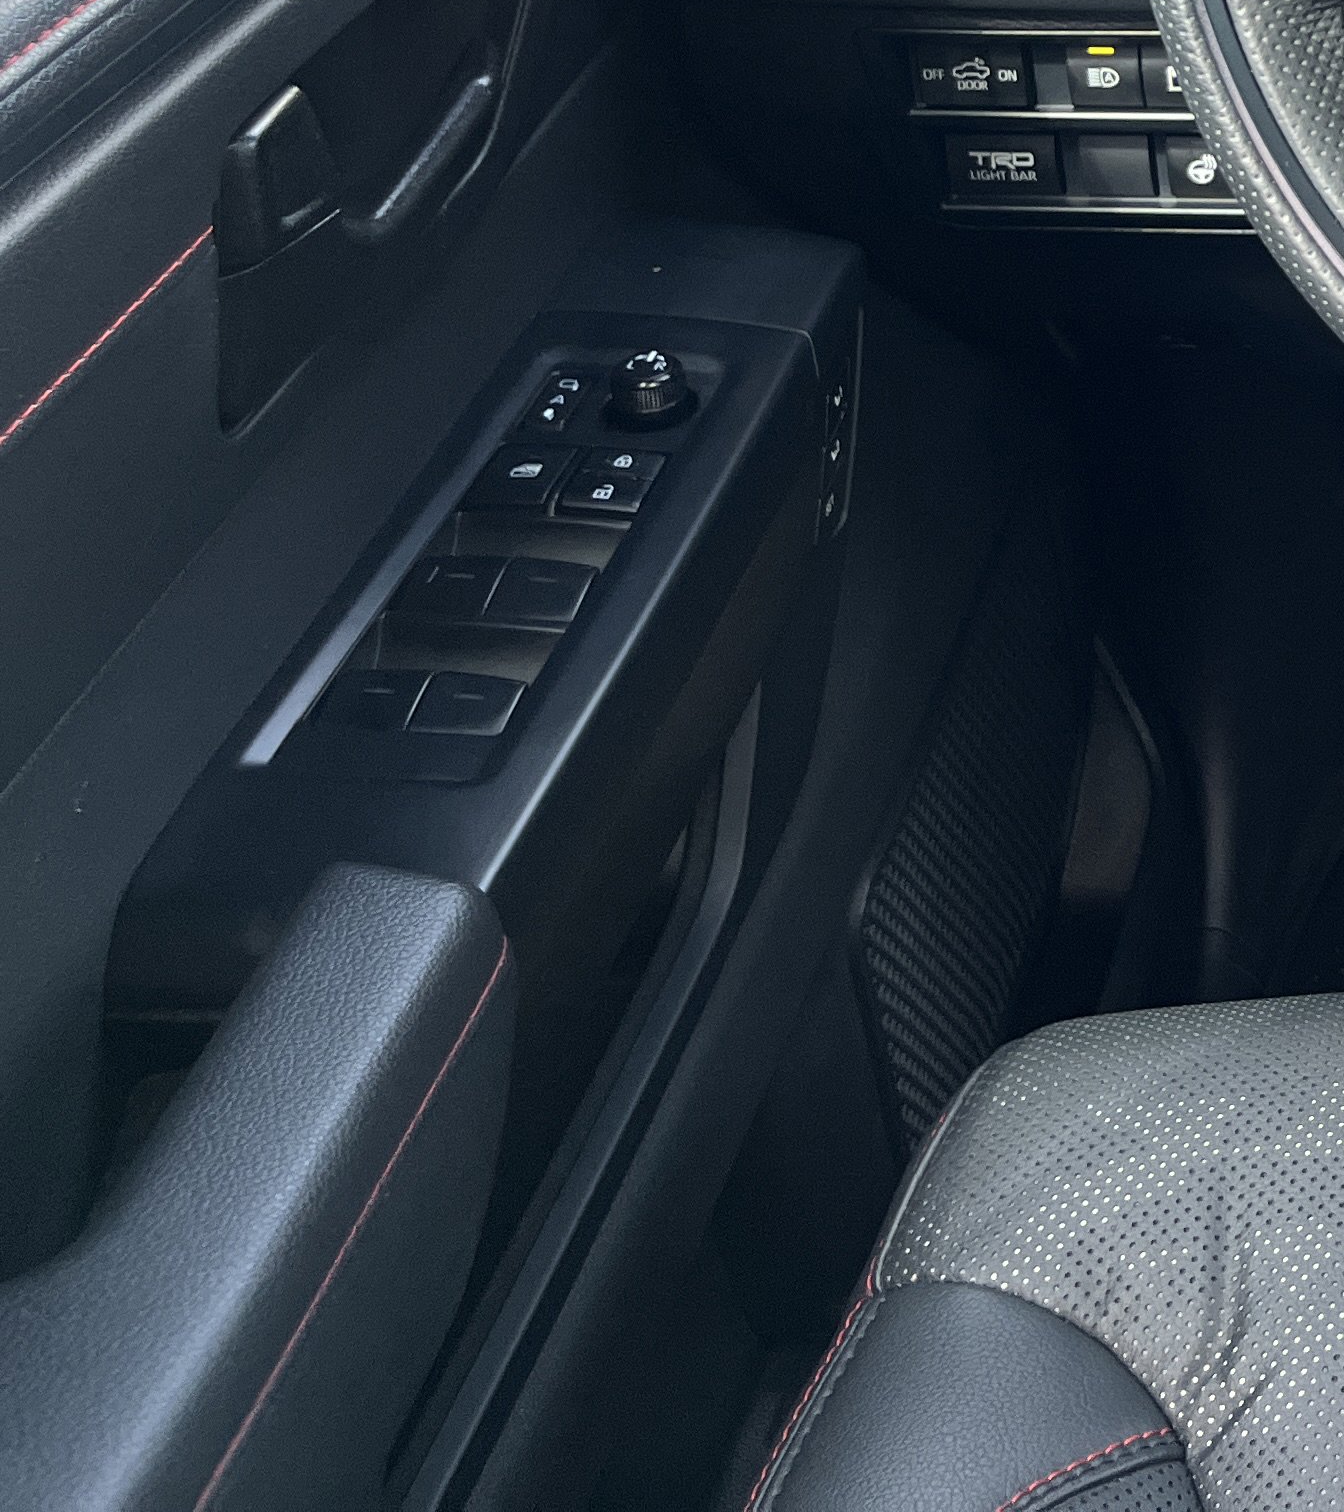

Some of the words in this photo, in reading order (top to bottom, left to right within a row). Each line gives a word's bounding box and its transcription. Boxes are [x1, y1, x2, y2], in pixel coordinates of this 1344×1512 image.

[922, 68, 945, 81] OFF
[998, 69, 1019, 83] ON
[957, 80, 989, 91] DOOR
[968, 151, 1035, 170] TRD
[969, 169, 1007, 181] LIGHT
[1010, 170, 1038, 182] BAR
